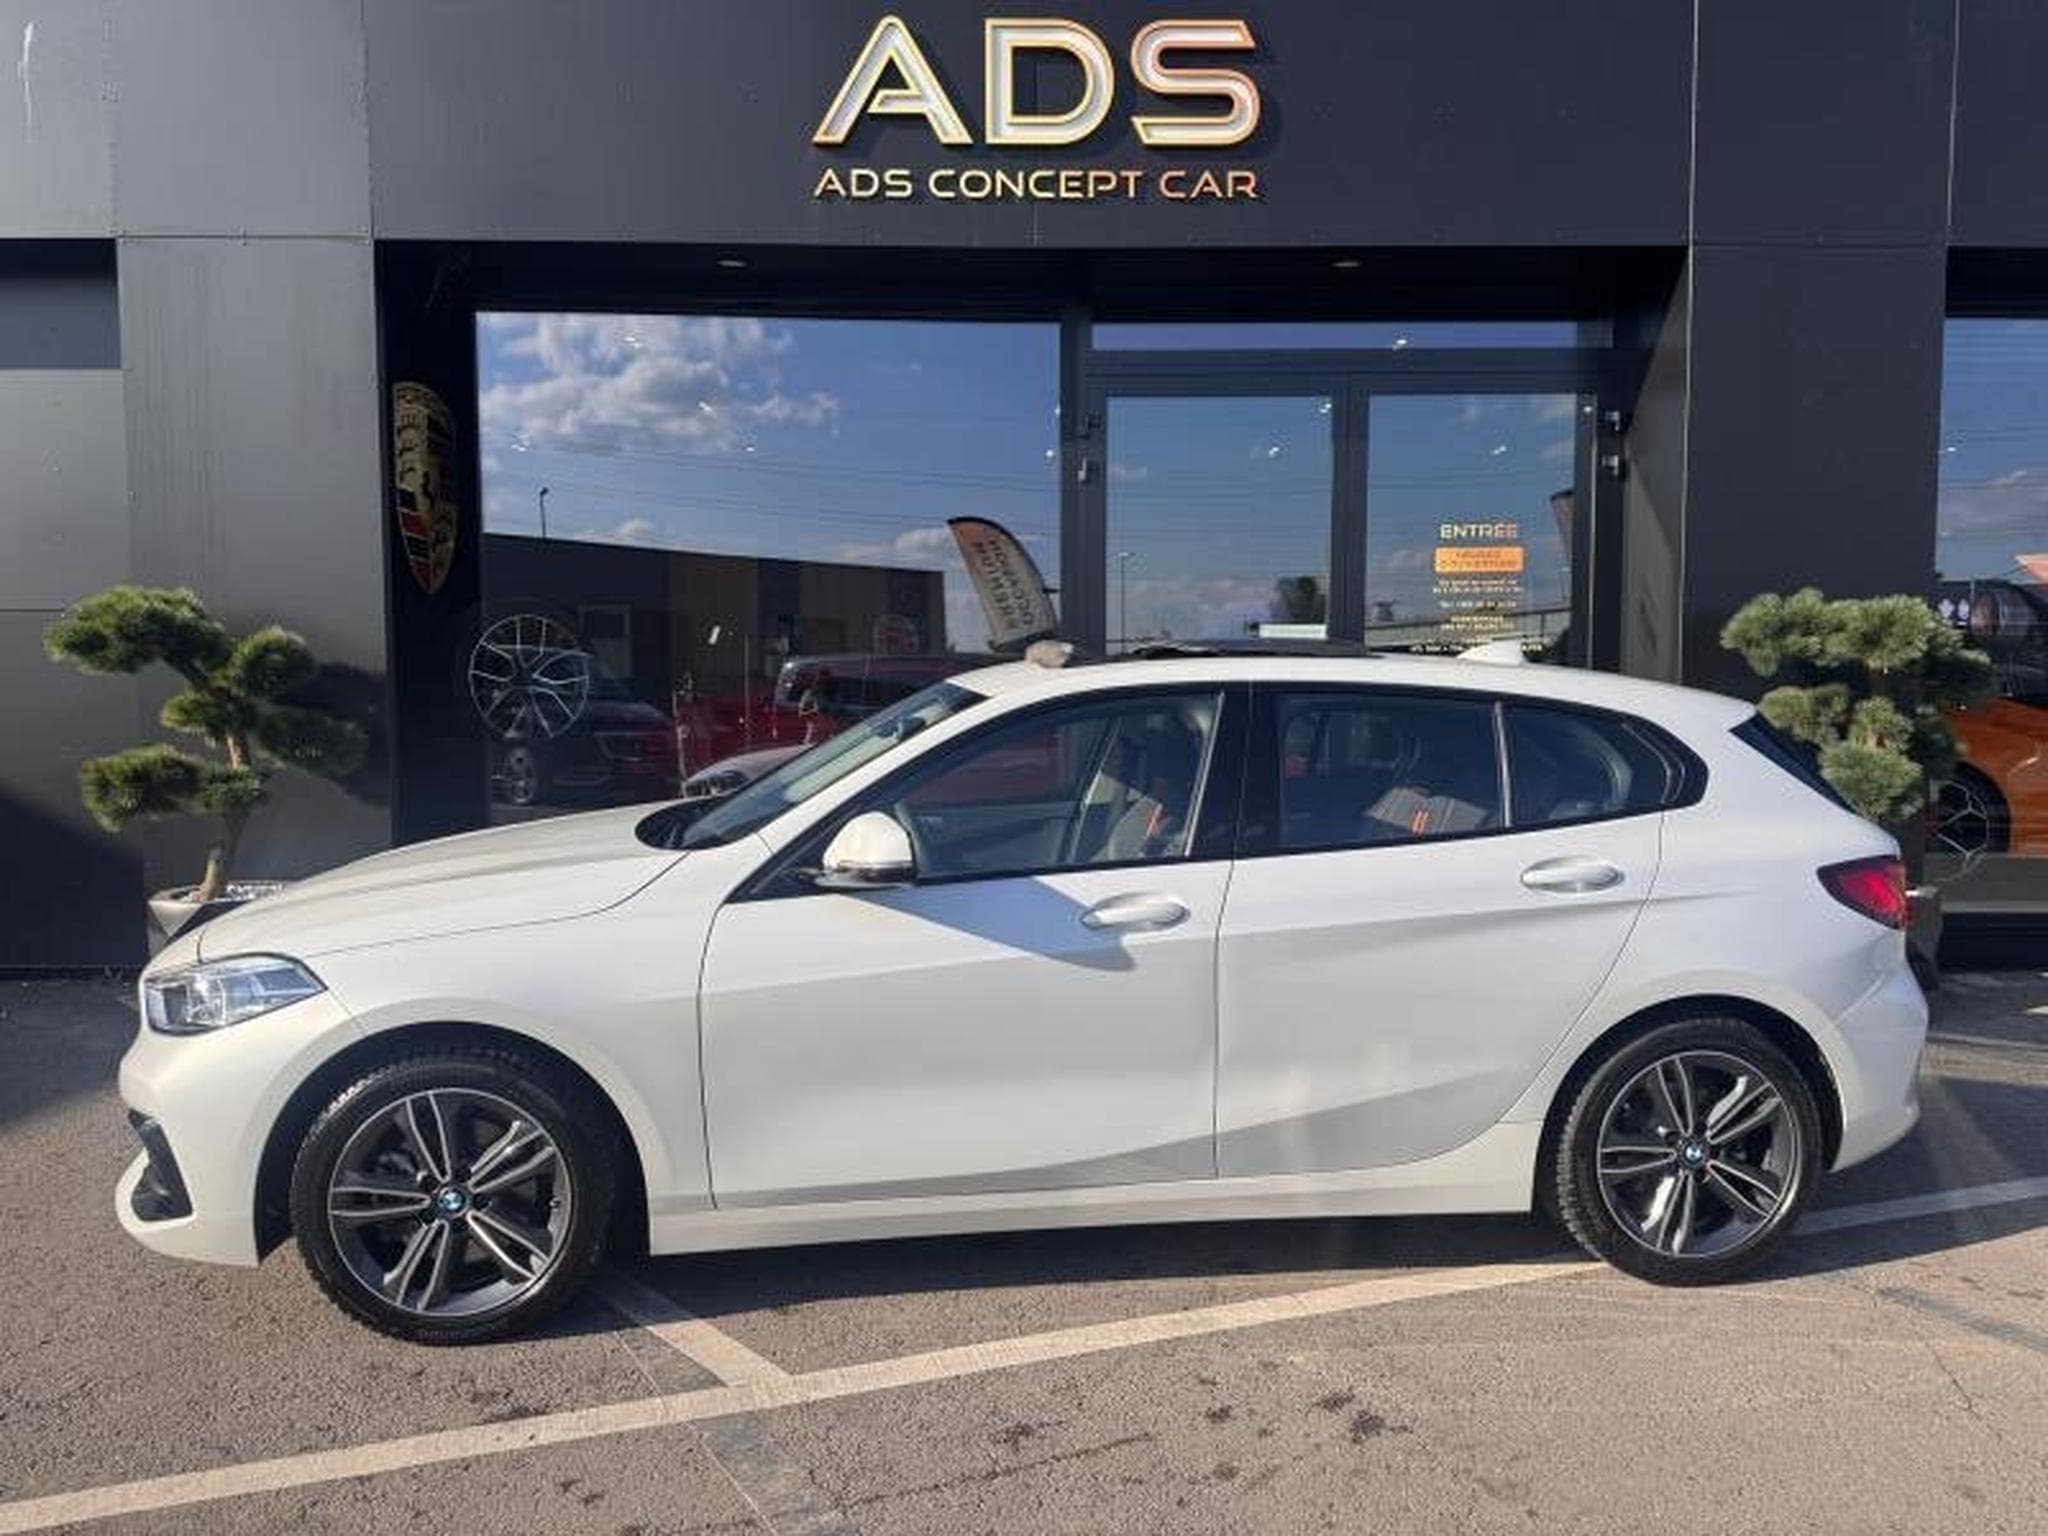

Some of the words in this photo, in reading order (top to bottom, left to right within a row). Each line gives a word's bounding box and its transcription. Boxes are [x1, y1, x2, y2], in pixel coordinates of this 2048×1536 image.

[812, 14, 1260, 145] ADS
[813, 168, 913, 198] ADS
[928, 168, 1143, 198] CONCEPT
[1159, 169, 1257, 198] CAR
